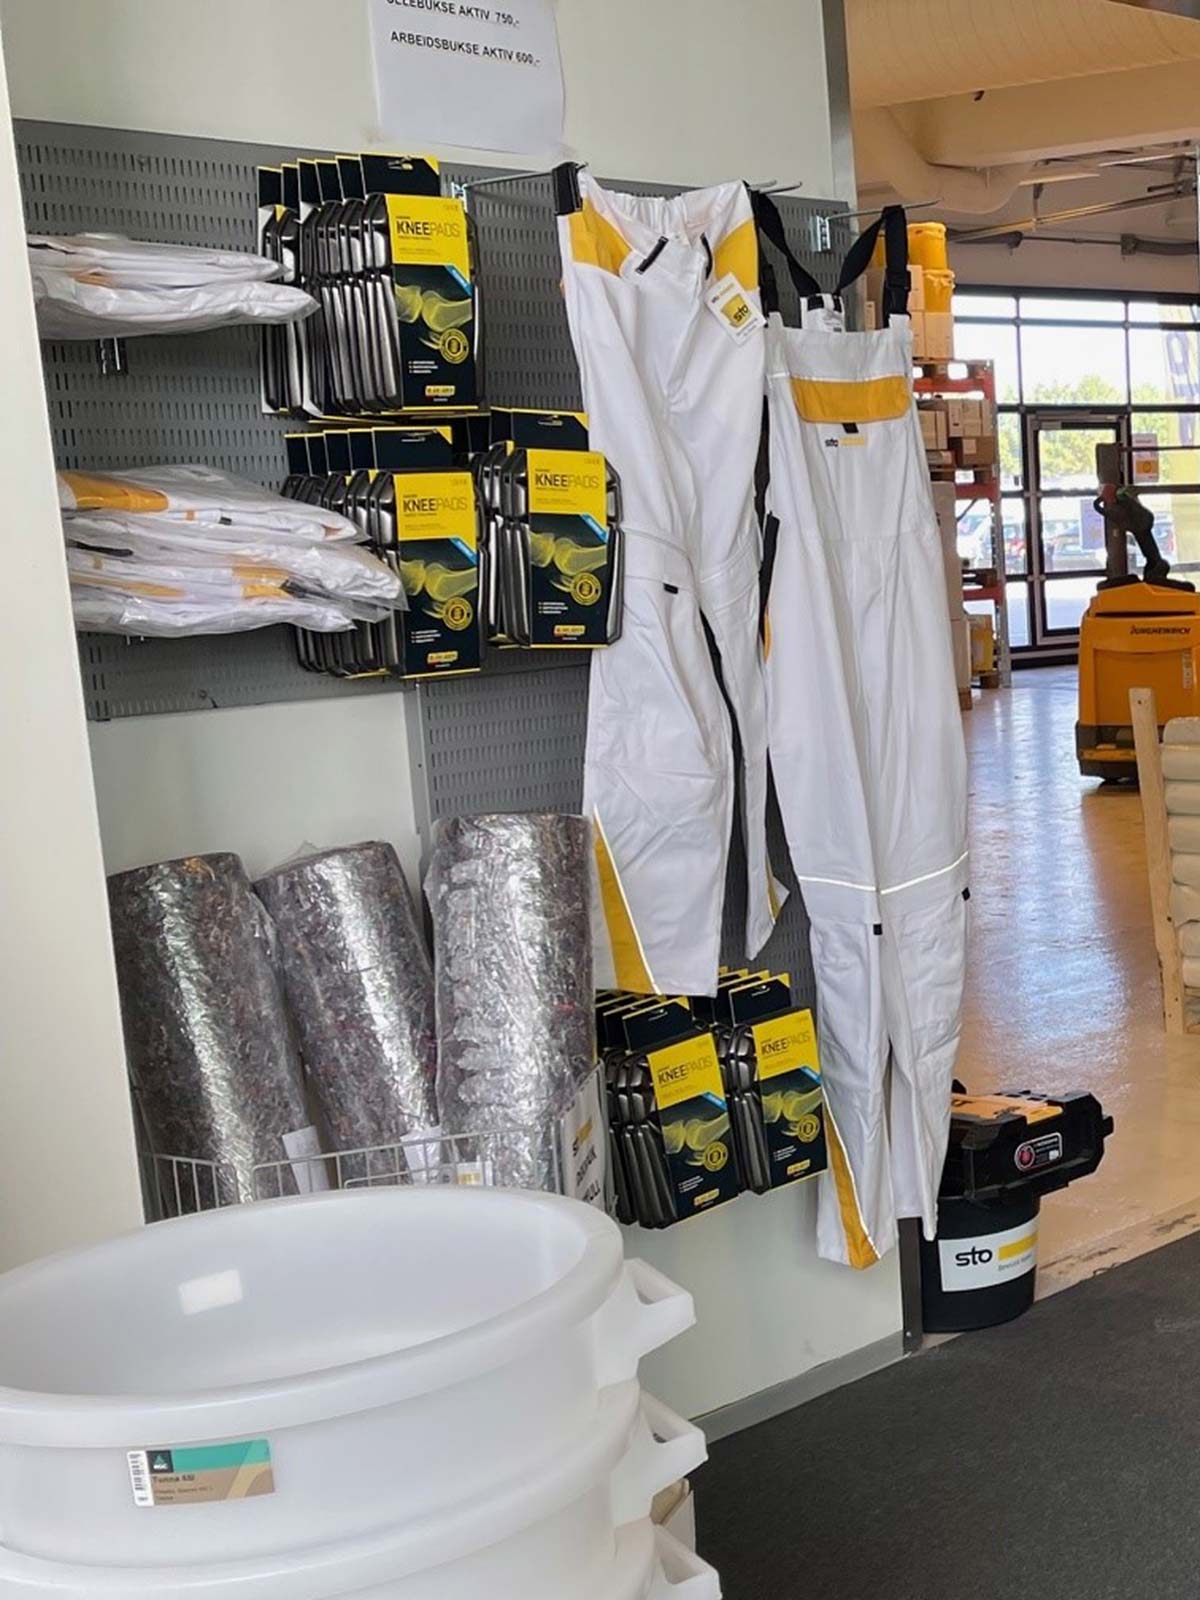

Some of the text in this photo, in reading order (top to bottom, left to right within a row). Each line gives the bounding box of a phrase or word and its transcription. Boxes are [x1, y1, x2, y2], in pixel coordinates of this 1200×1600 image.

[458, 7, 490, 21] AKTIV
[390, 31, 480, 56] ARBEIDSBUKSE
[482, 46, 514, 62] AKTIV
[396, 220, 460, 238] KNEEPADS
[732, 304, 749, 322] sto
[534, 473, 600, 489] KNEEPADS
[403, 496, 468, 513] KNEEPADS
[761, 1030, 811, 1056] KNEEPADS
[657, 1055, 713, 1085] KNEEPADS
[955, 1246, 993, 1267] sto
